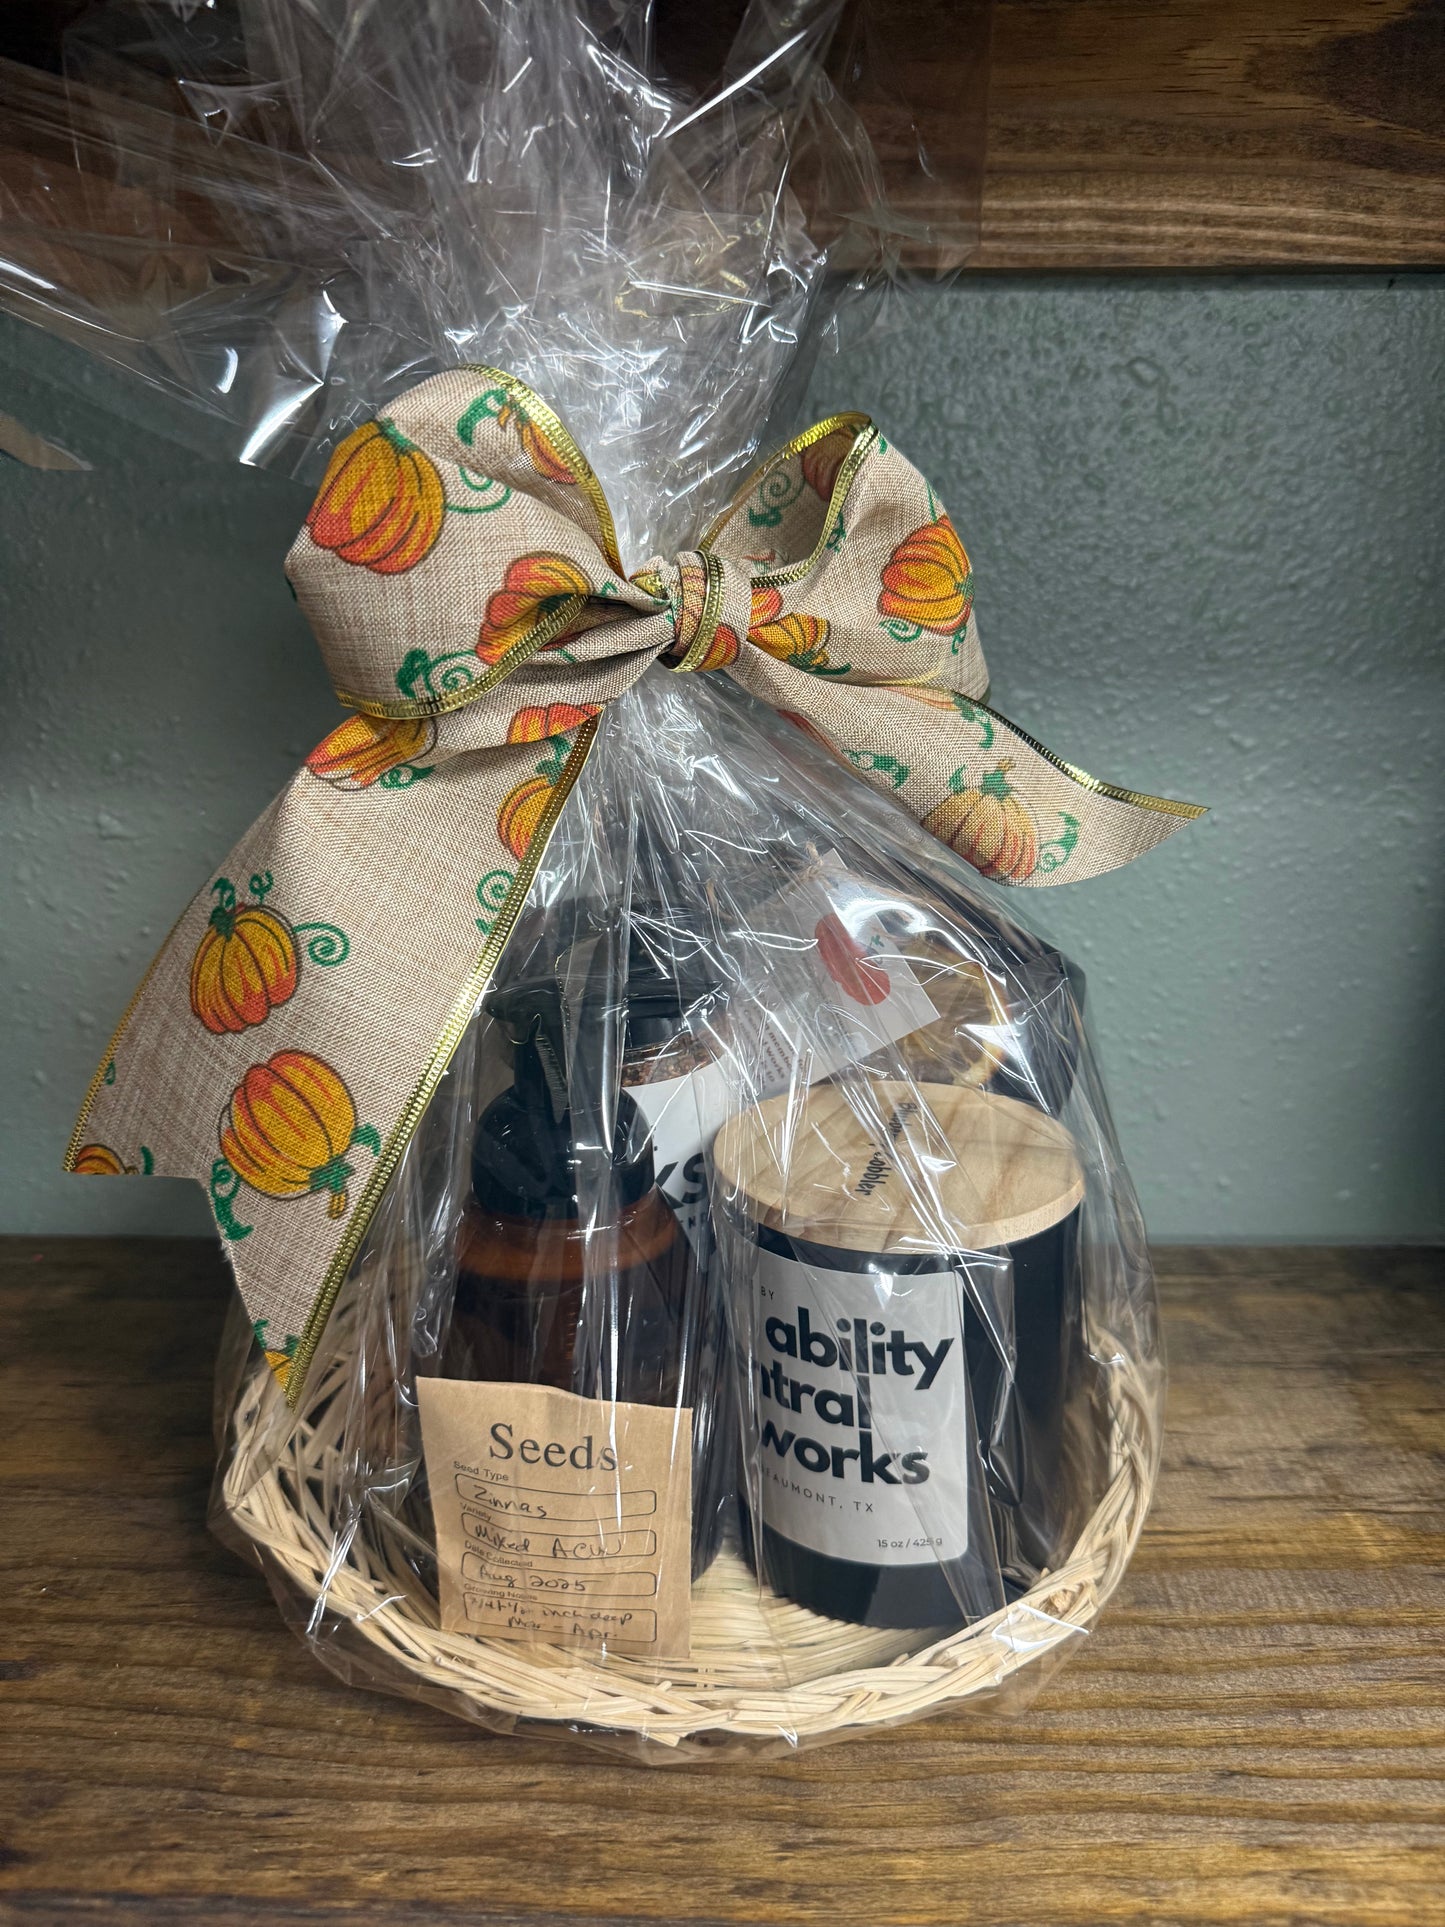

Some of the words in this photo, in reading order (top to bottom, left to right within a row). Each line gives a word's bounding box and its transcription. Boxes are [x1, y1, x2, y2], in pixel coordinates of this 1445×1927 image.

[765, 1306, 955, 1390] ability
[489, 1422, 618, 1472] Seeds
[453, 1460, 480, 1475] Seed
[483, 1468, 509, 1481] Type
[853, 1501, 874, 1513] TX
[877, 1538, 888, 1548] 15
[891, 1540, 903, 1548] oz
[529, 1575, 604, 1591] 2025
